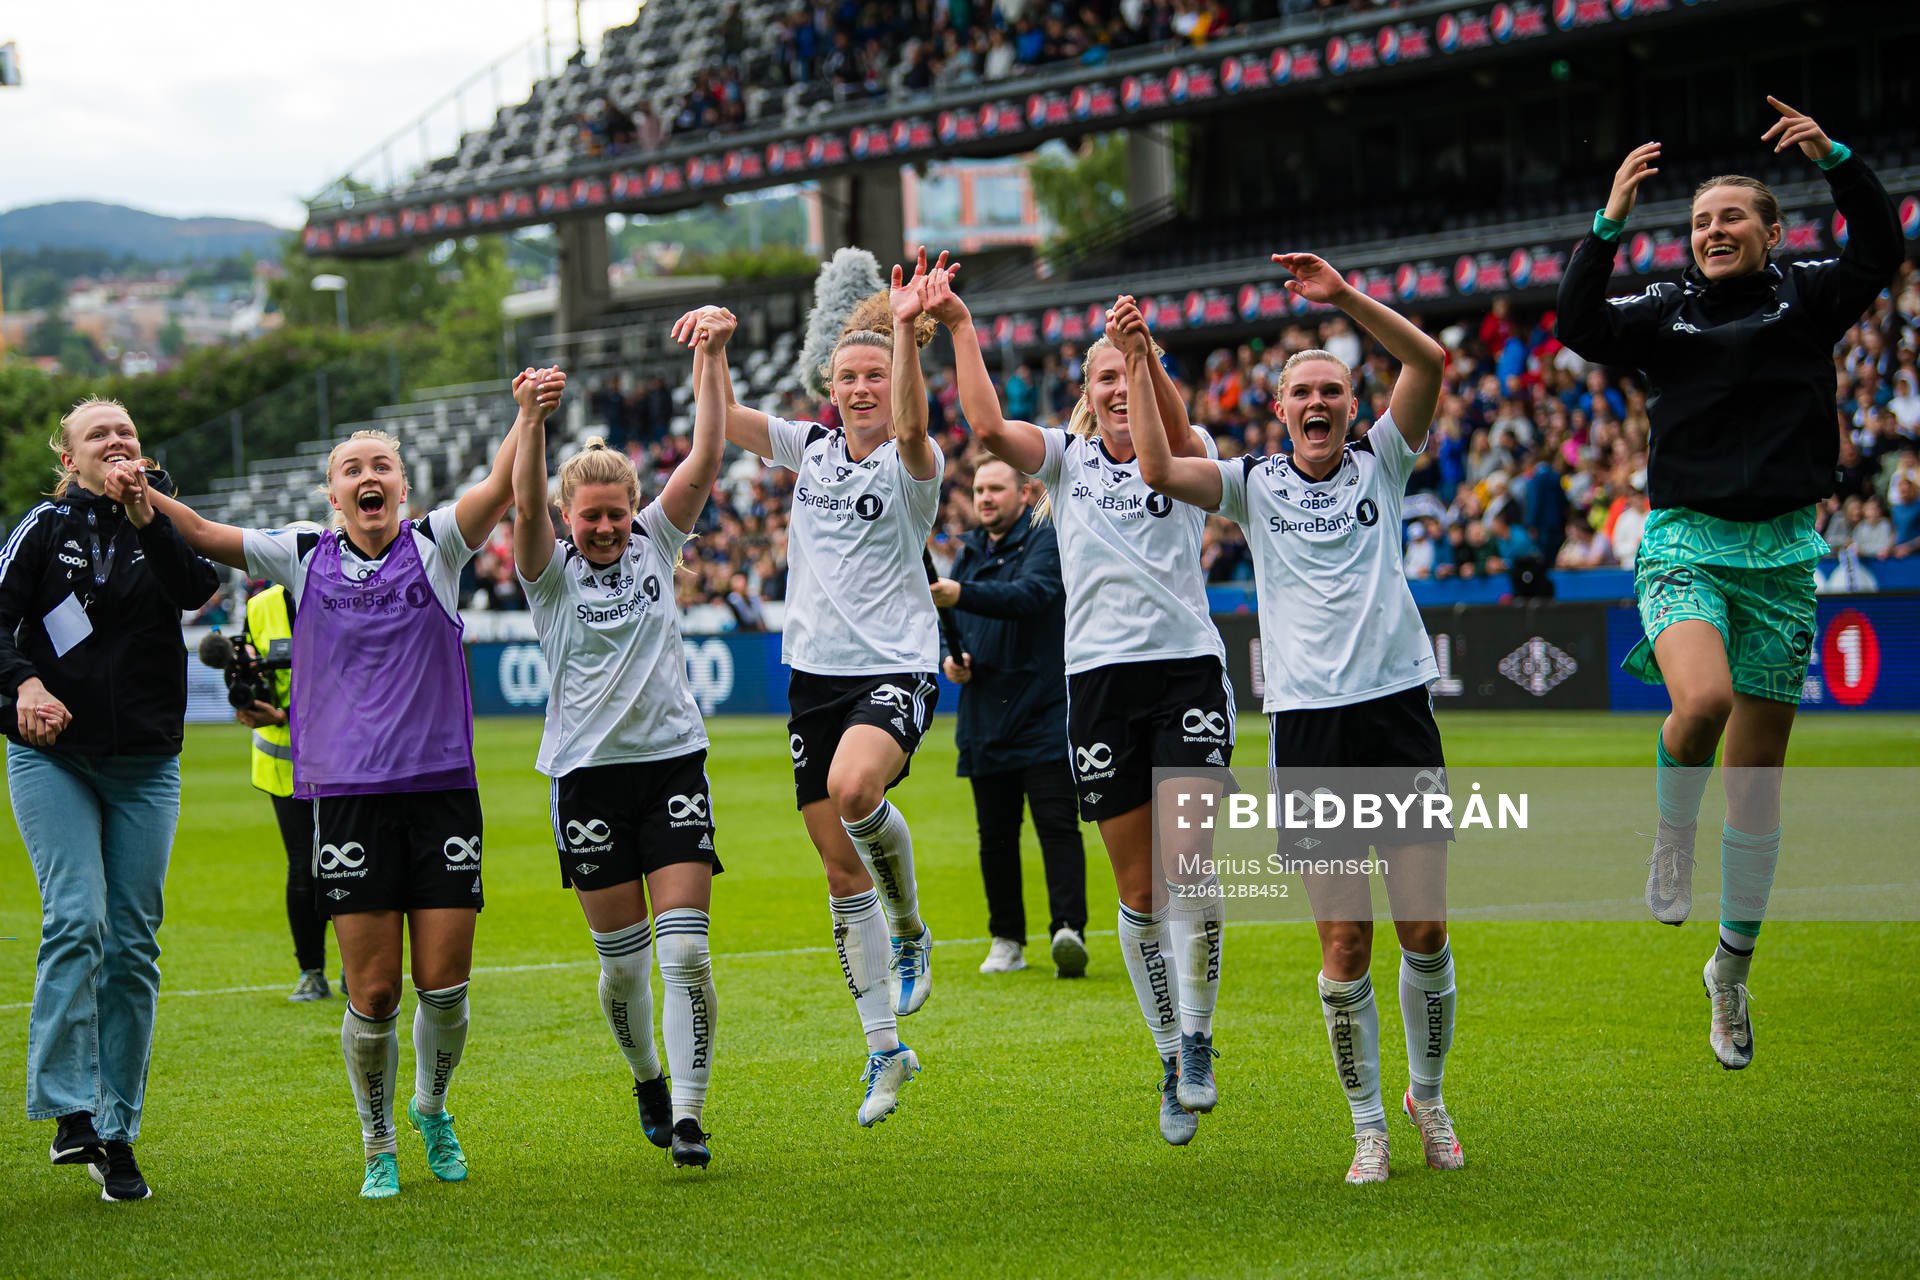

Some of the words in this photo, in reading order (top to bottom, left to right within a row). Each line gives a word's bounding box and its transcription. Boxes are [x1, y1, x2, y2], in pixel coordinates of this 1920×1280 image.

[797, 487, 855, 510] SreBank
[1300, 497, 1337, 510] OBOS
[1121, 511, 1145, 520] SMN
[1269, 512, 1355, 534] SpareBank
[58, 553, 88, 568] coop
[66, 569, 73, 580] 6
[322, 587, 402, 610] SpareBank
[383, 604, 407, 616] SMN
[446, 862, 480, 872] TrønderEnerg
[868, 841, 901, 900] RAMIREN
[1203, 905, 1220, 983] RAMIRE
[833, 921, 863, 1000] RAMIREN
[1140, 941, 1176, 1026] RAMIRENT
[612, 998, 636, 1049] RAMIRENT
[688, 986, 709, 1070] RAMIRENT
[1424, 990, 1443, 1059] RAMIRENT
